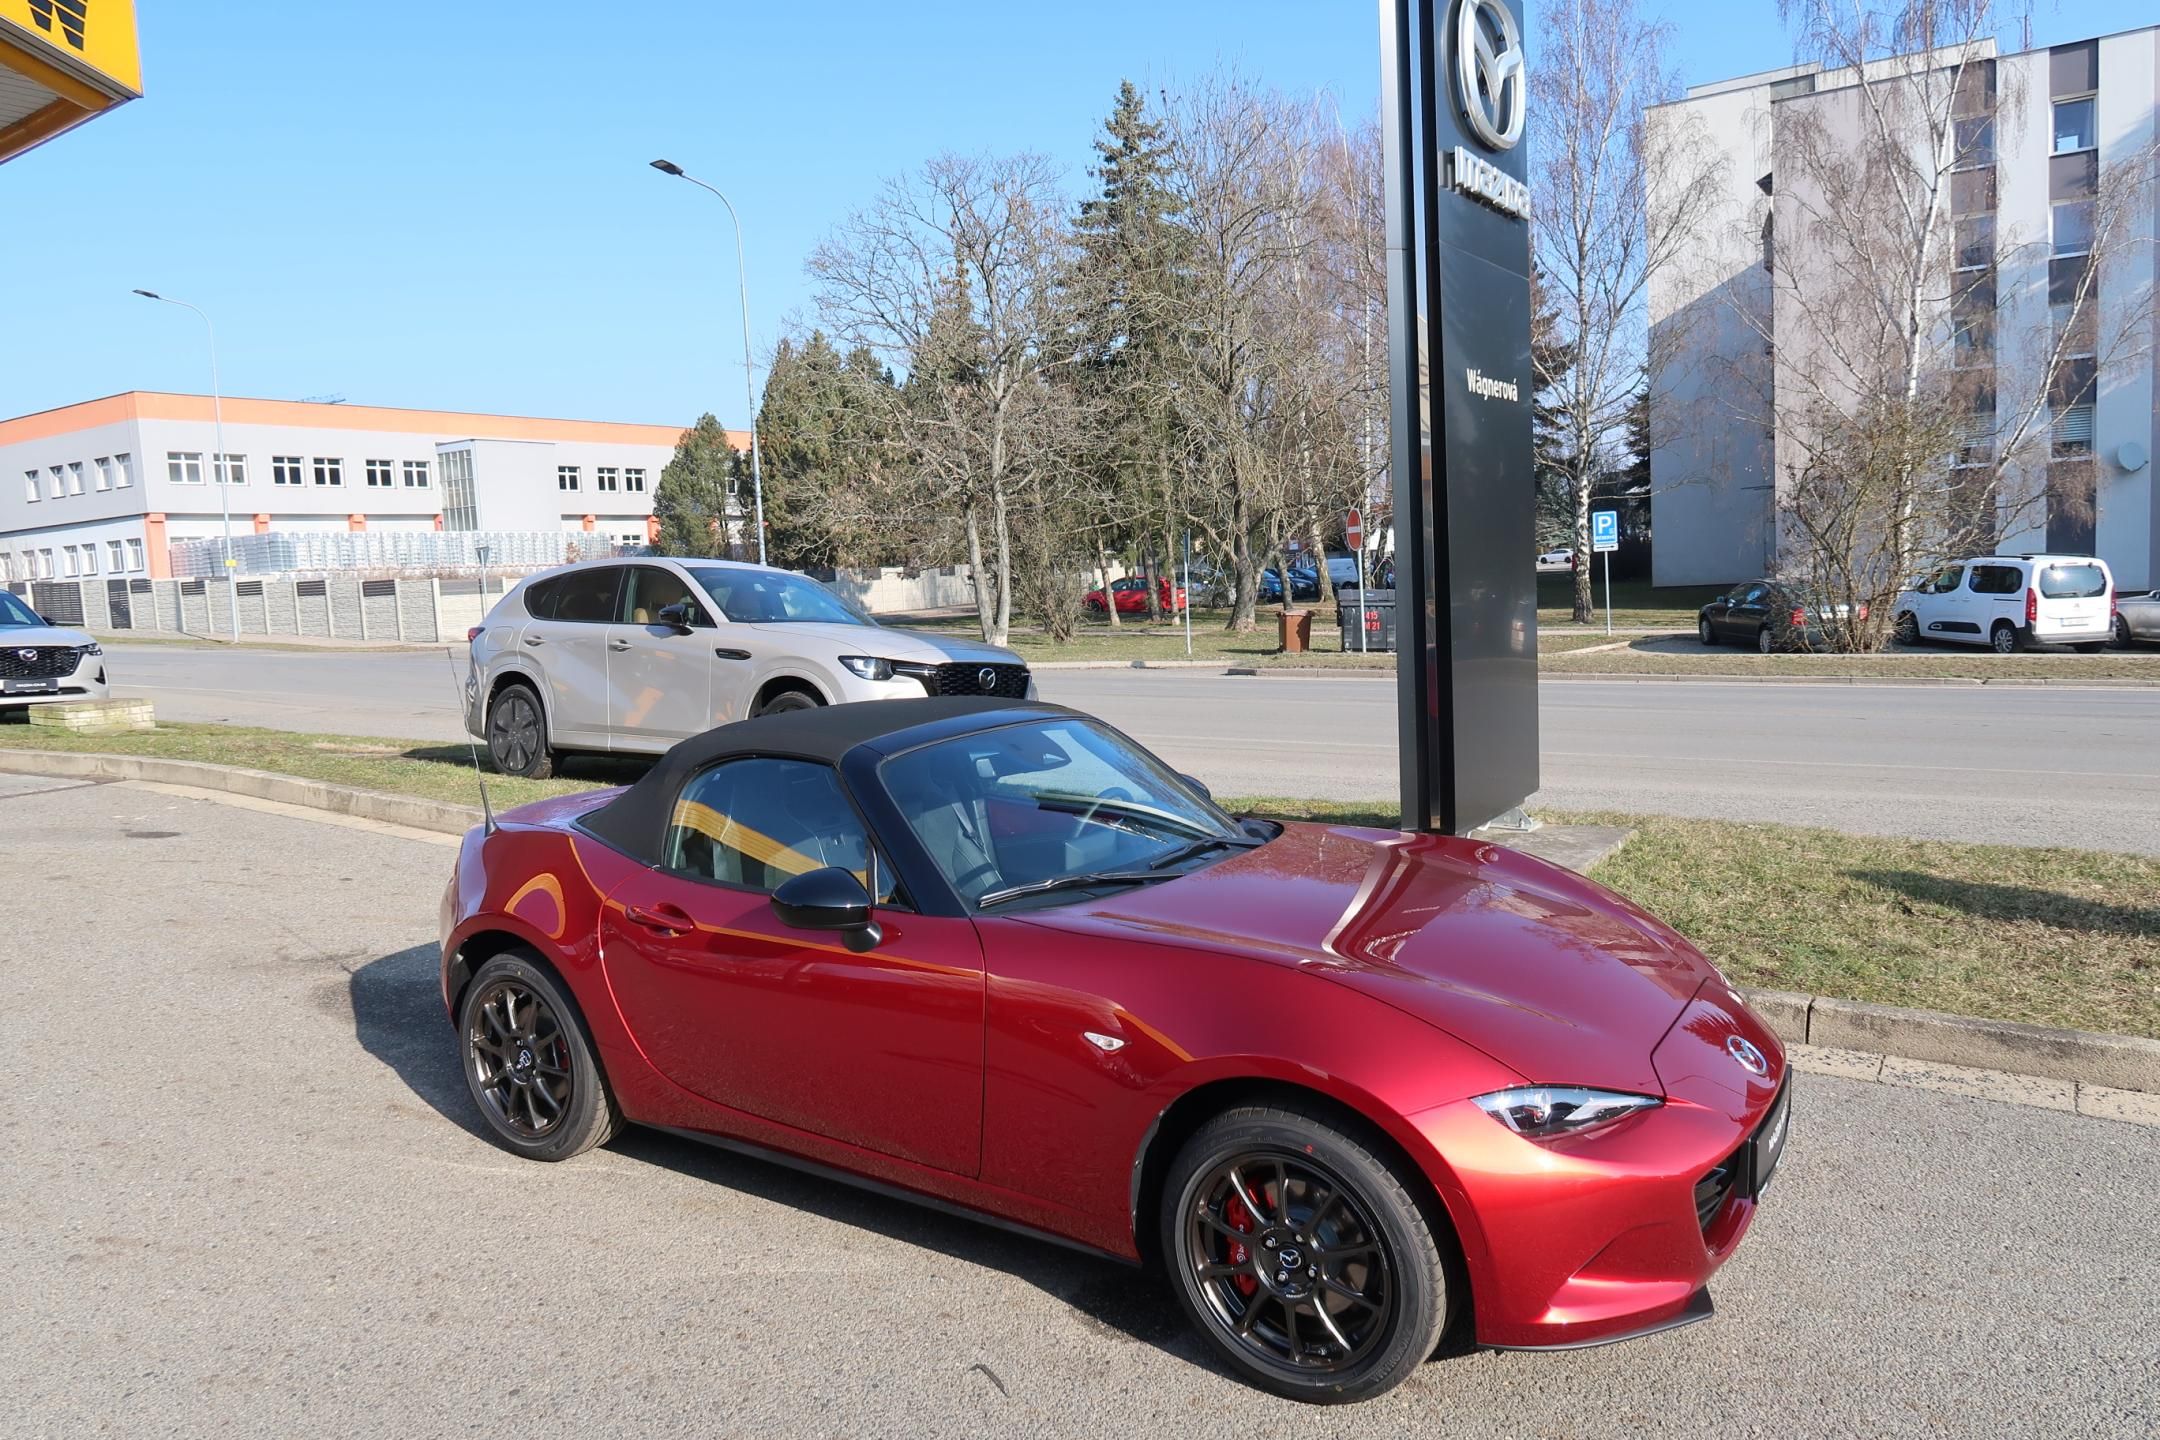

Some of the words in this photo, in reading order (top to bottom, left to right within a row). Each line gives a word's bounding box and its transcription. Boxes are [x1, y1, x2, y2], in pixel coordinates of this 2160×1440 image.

[1454, 145, 1531, 220] mazda
[1466, 367, 1518, 402] Wágnerová
[1598, 515, 1612, 534] P
